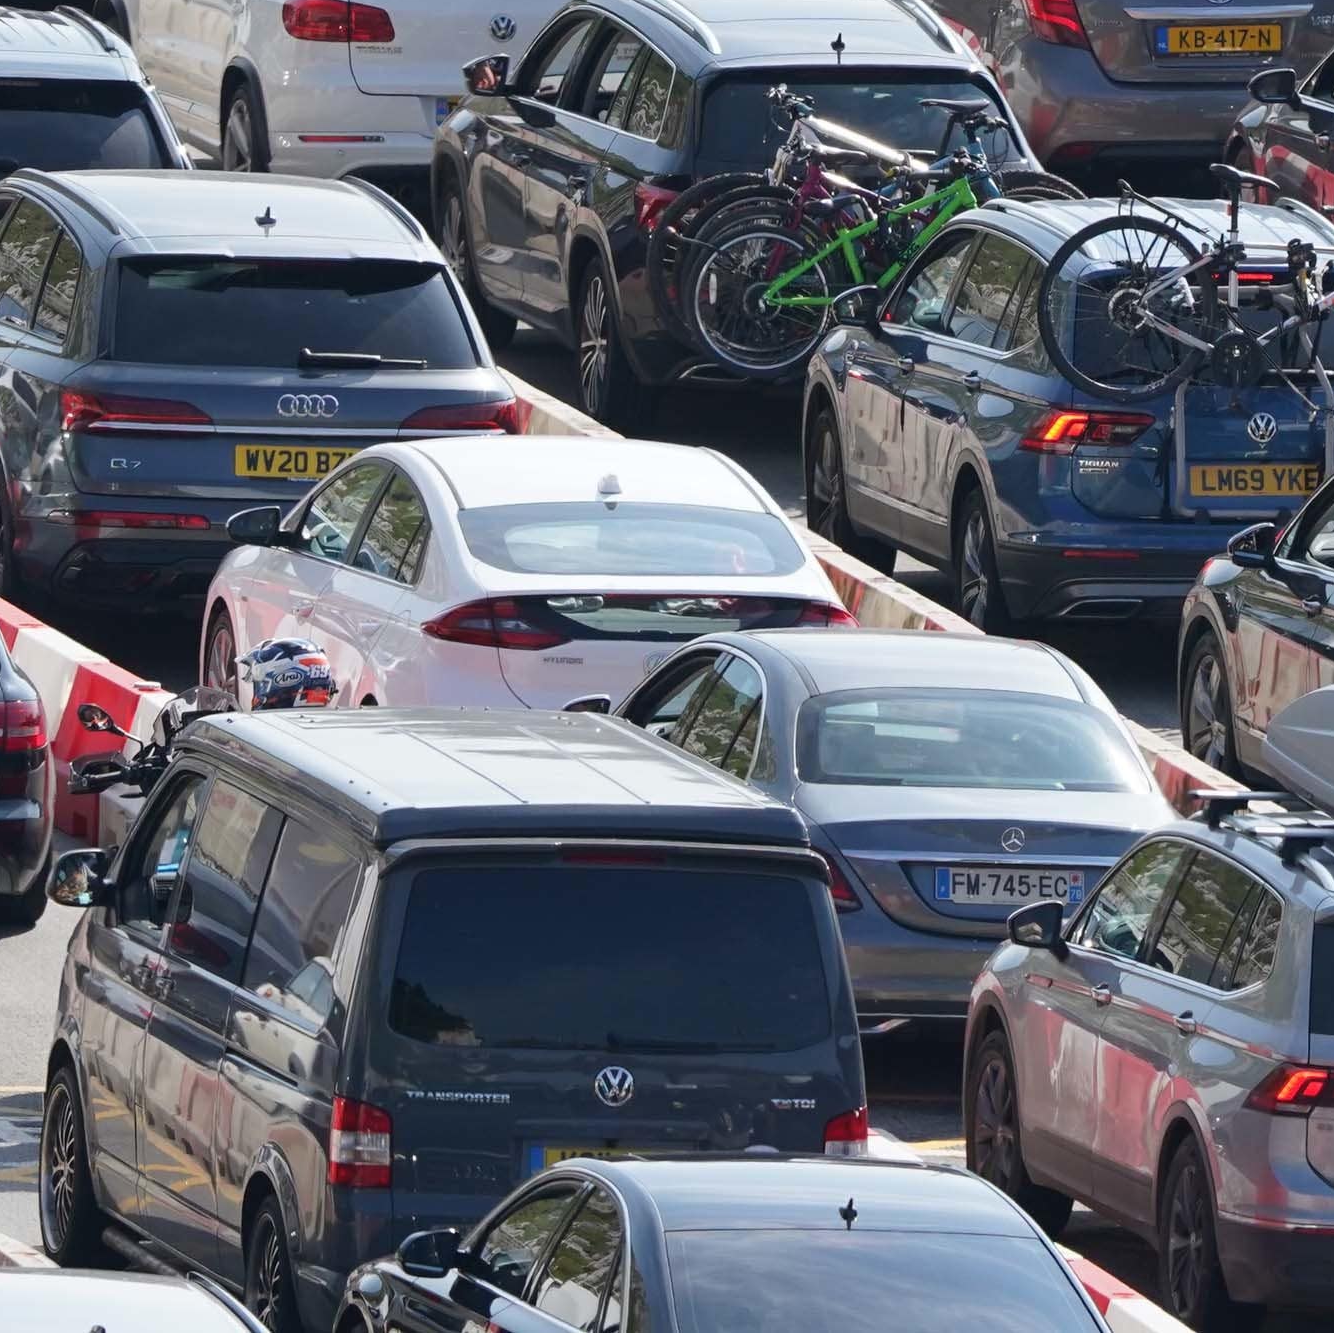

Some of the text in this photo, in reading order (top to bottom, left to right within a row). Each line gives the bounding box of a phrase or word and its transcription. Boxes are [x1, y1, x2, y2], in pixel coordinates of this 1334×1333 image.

[1177, 28, 1274, 53] KB-417-N
[246, 449, 310, 472] WV20
[1078, 460, 1120, 468] TIGUAN
[1200, 470, 1317, 495] LM69 YKE
[274, 671, 304, 684] Arai
[951, 872, 1068, 899] FM-745-EC
[405, 1090, 511, 1104] TRANSPORTER
